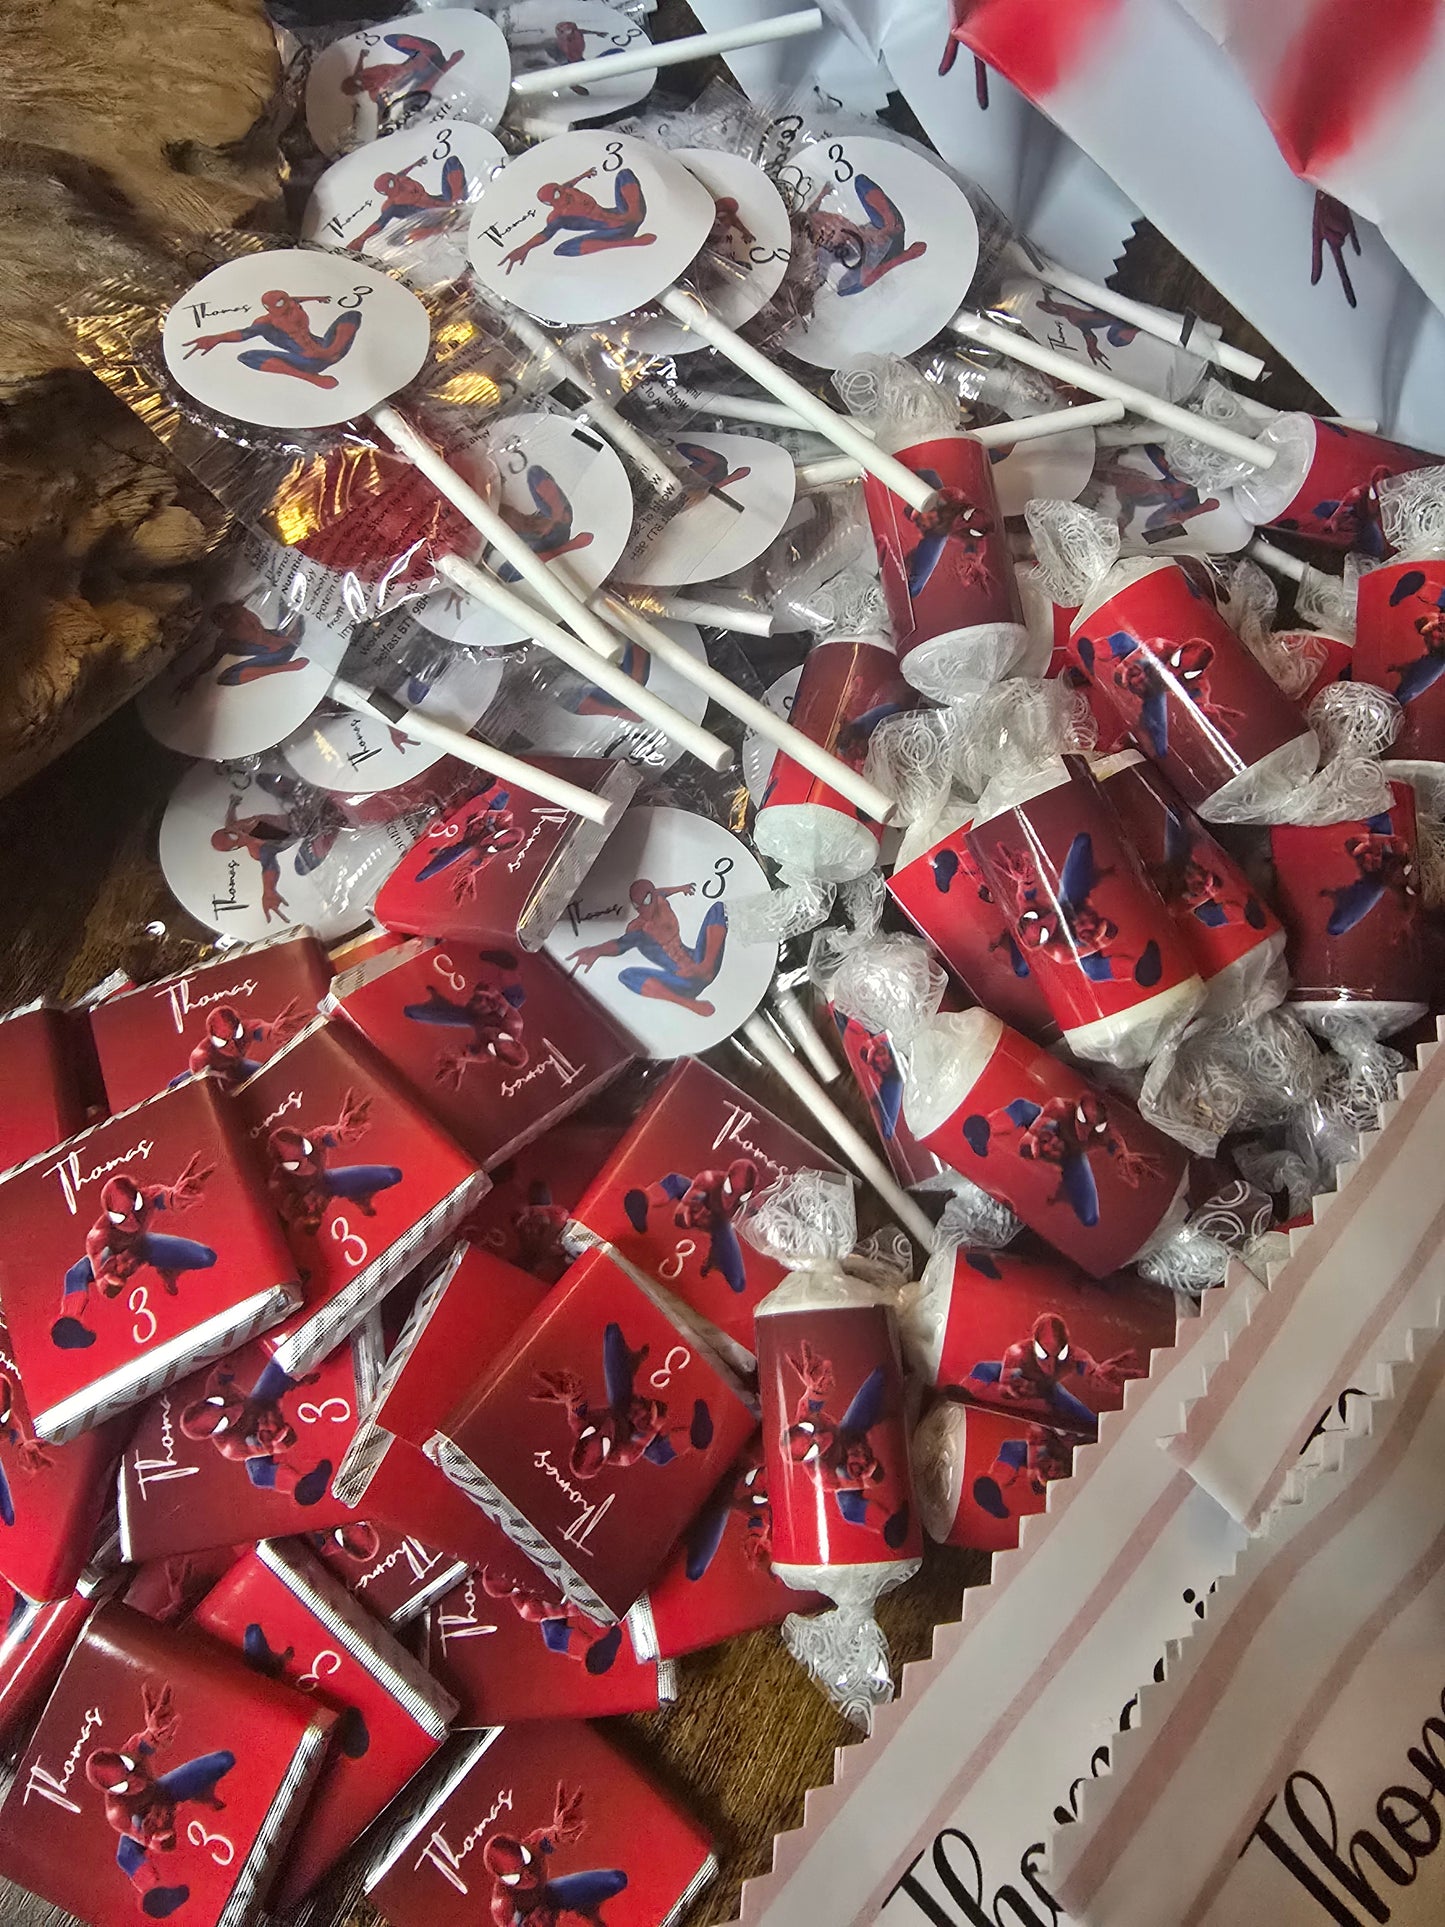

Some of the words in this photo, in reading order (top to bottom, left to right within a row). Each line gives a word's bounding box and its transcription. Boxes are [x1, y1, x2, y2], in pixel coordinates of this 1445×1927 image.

[612, 28, 643, 47] 3
[433, 129, 453, 161] 3
[603, 142, 624, 172] 3
[828, 143, 854, 183] 3
[321, 199, 373, 239] Thomas
[478, 206, 537, 248] Thomas
[749, 246, 791, 266] 3
[189, 299, 252, 328] Thomas
[338, 285, 374, 309] 3
[409, 590, 431, 616] 9BH
[347, 719, 382, 772] Thomas
[429, 820, 458, 840] 3
[508, 806, 572, 874] Thomas
[211, 859, 249, 921] Thomas
[702, 857, 734, 899] 3
[566, 899, 625, 938] Thomas
[432, 953, 467, 991] 3
[154, 977, 259, 1034] Thomas
[500, 1036, 587, 1098] Thomas
[250, 1090, 304, 1138] omas
[712, 1100, 788, 1180] Thomas
[42, 1138, 155, 1215] Thomas
[331, 1216, 368, 1267] 3
[659, 1239, 696, 1279] 3
[127, 1286, 157, 1343] 3
[649, 1346, 691, 1388] 3
[297, 1397, 351, 1424] 3
[533, 1449, 616, 1557] Thomas
[295, 1650, 341, 1692] 3
[23, 1707, 103, 1814] Thomas
[187, 1820, 234, 1866] 3
[414, 1788, 513, 1895] Thomas
